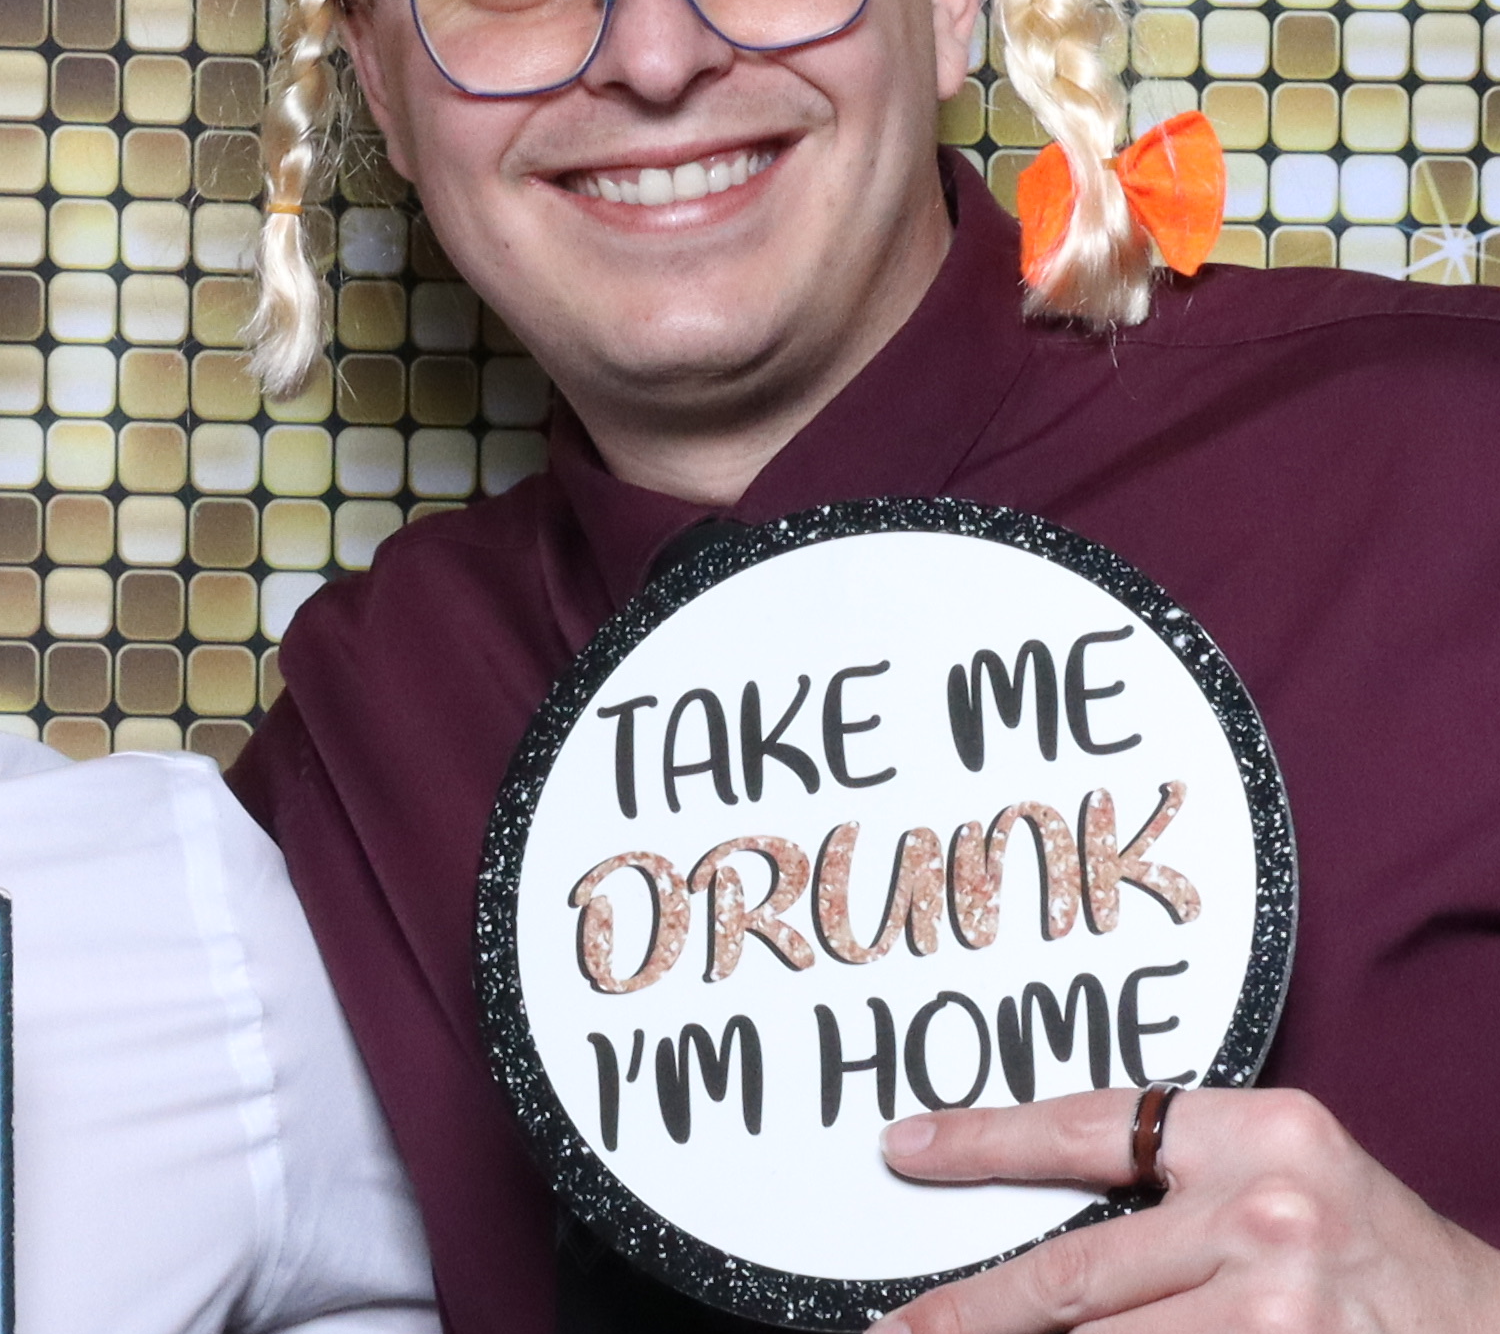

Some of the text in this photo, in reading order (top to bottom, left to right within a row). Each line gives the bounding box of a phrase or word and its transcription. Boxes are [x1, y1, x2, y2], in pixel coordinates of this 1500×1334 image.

[596, 625, 1142, 820] TAKE ME
[567, 781, 1202, 996] DRUNK
[587, 960, 1198, 1152] I'M HOME
